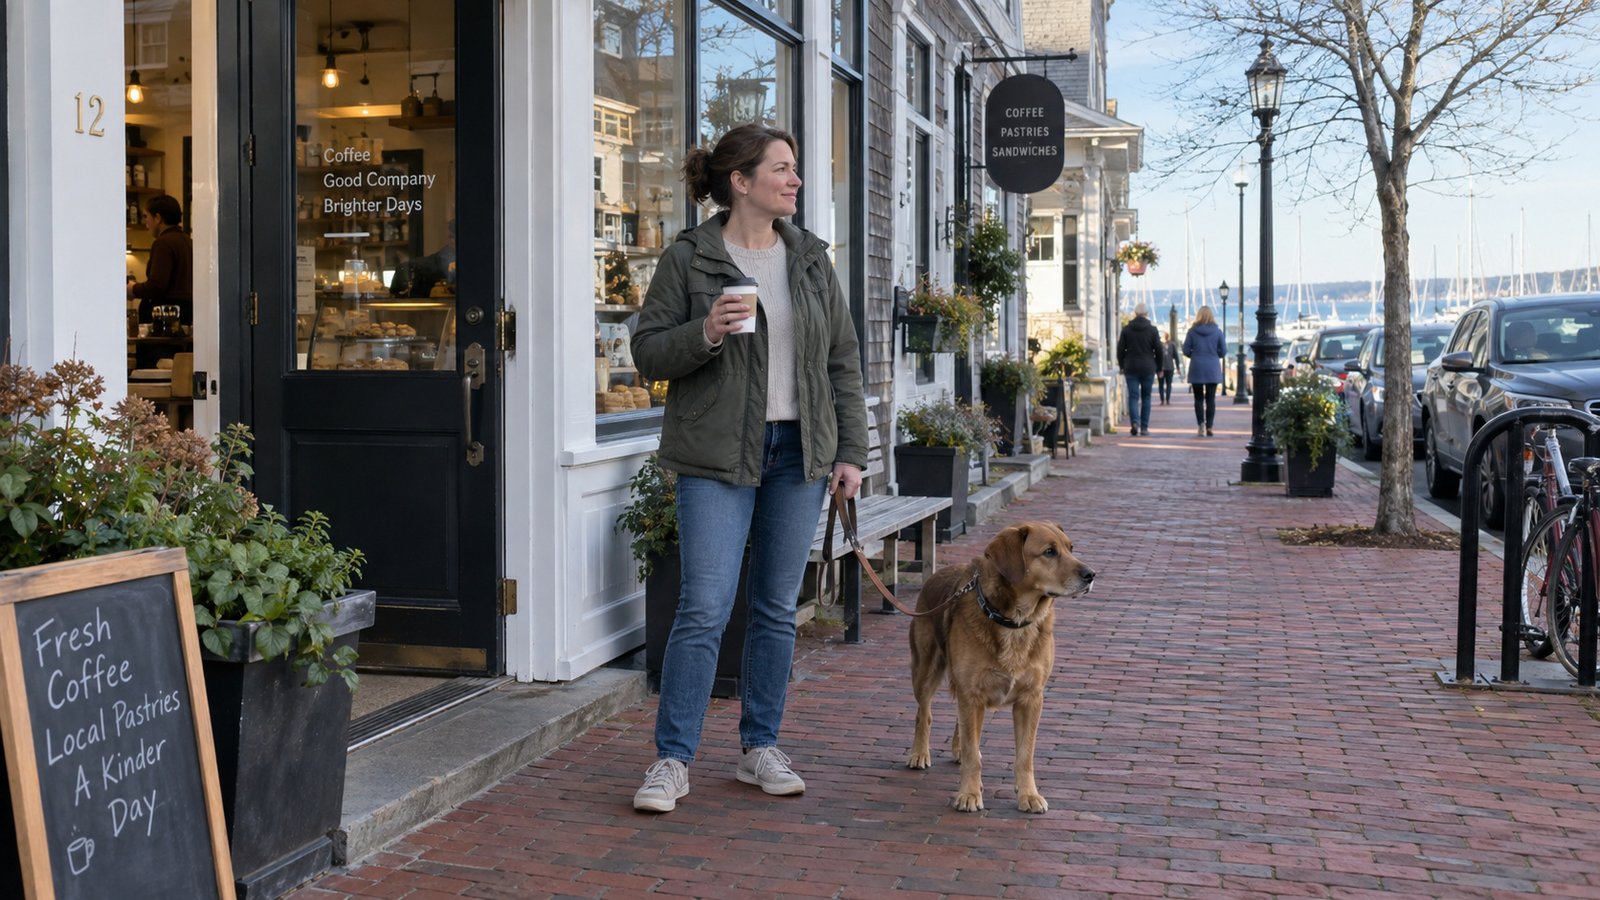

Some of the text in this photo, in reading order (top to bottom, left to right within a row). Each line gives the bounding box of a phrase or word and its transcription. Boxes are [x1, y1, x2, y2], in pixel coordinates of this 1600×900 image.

[75, 92, 105, 137] 12
[1005, 107, 1044, 118] COFFEE
[1001, 126, 1050, 137] PASTRIES
[324, 147, 371, 163] Coffee
[992, 145, 1058, 157] SANDWICHES
[324, 172, 436, 190] Good Company
[324, 197, 422, 217] Brighter Days
[33, 606, 111, 667] Fresh
[47, 653, 133, 710] Coffee
[46, 690, 181, 766] Local Pastries
[74, 739, 167, 806] A Kinder
[108, 789, 157, 837] Day
